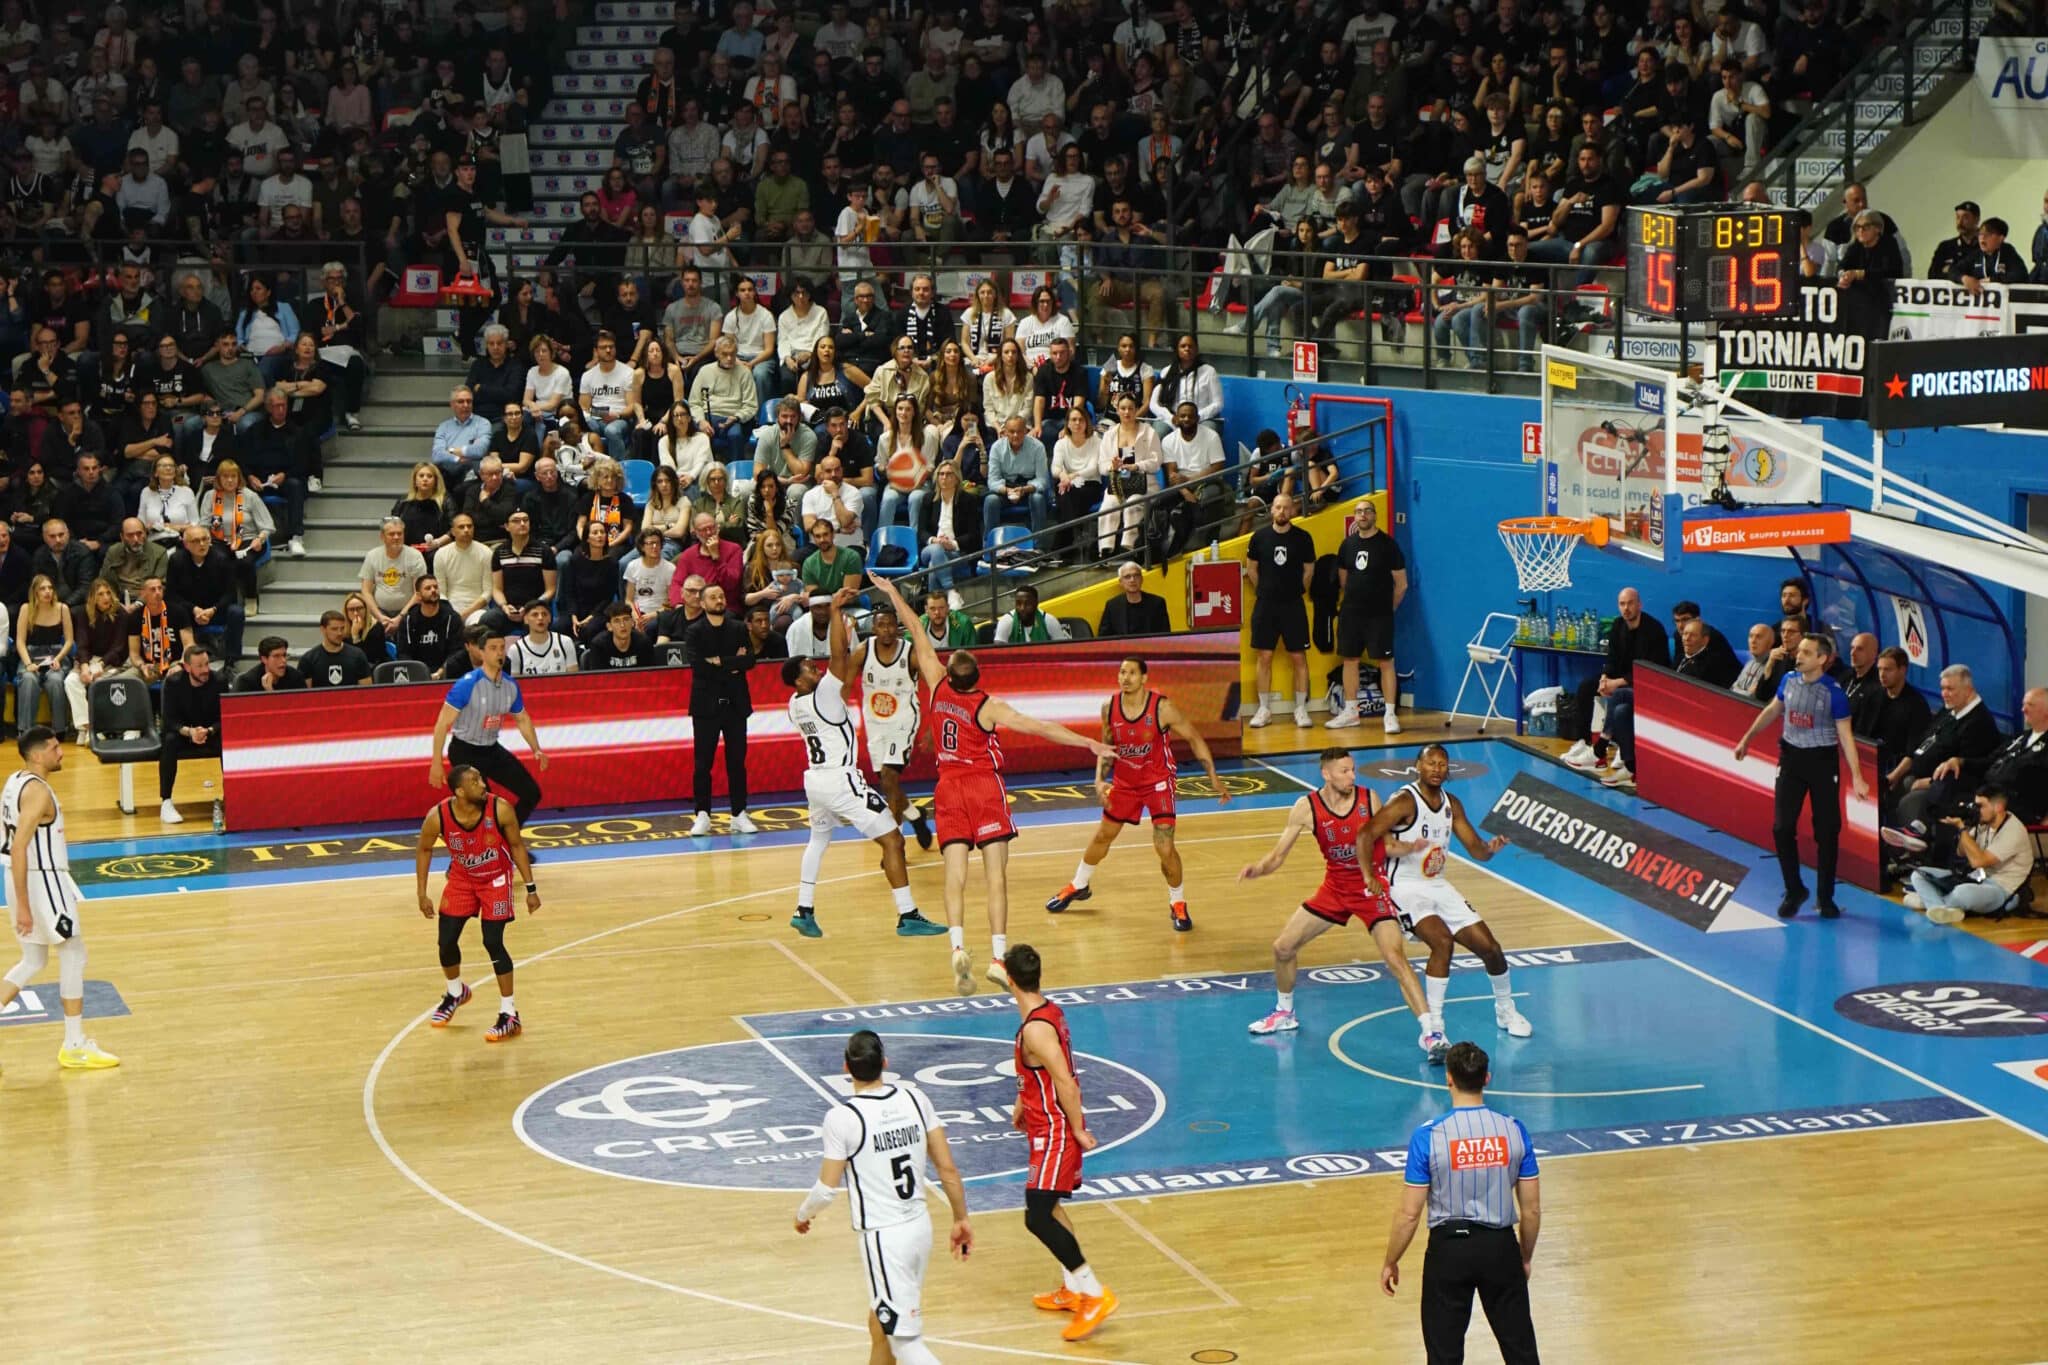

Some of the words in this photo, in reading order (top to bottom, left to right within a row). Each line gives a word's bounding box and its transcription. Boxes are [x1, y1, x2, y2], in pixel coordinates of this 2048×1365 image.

[1642, 213, 1675, 247] 8:37
[1716, 215, 1783, 248] 8:37
[1728, 252, 1782, 312] 1.5
[1719, 329, 1865, 371] TORNIAMO
[1768, 373, 1816, 390] UDINE
[1712, 530, 1746, 545] Bank
[807, 735, 827, 765] 8
[942, 719, 959, 752] 8
[1421, 824, 1429, 839] 6
[1492, 789, 1736, 911] POKERSTARSNEWS.IT
[1156, 976, 1252, 993] Ag.
[1852, 991, 1965, 1031] ENERGY
[1901, 985, 2048, 1025] SKY
[1456, 1137, 1503, 1155] ATTAL
[1456, 1152, 1505, 1165] GROUP
[890, 1153, 916, 1201] 5
[1071, 1165, 1281, 1197] Allianz
